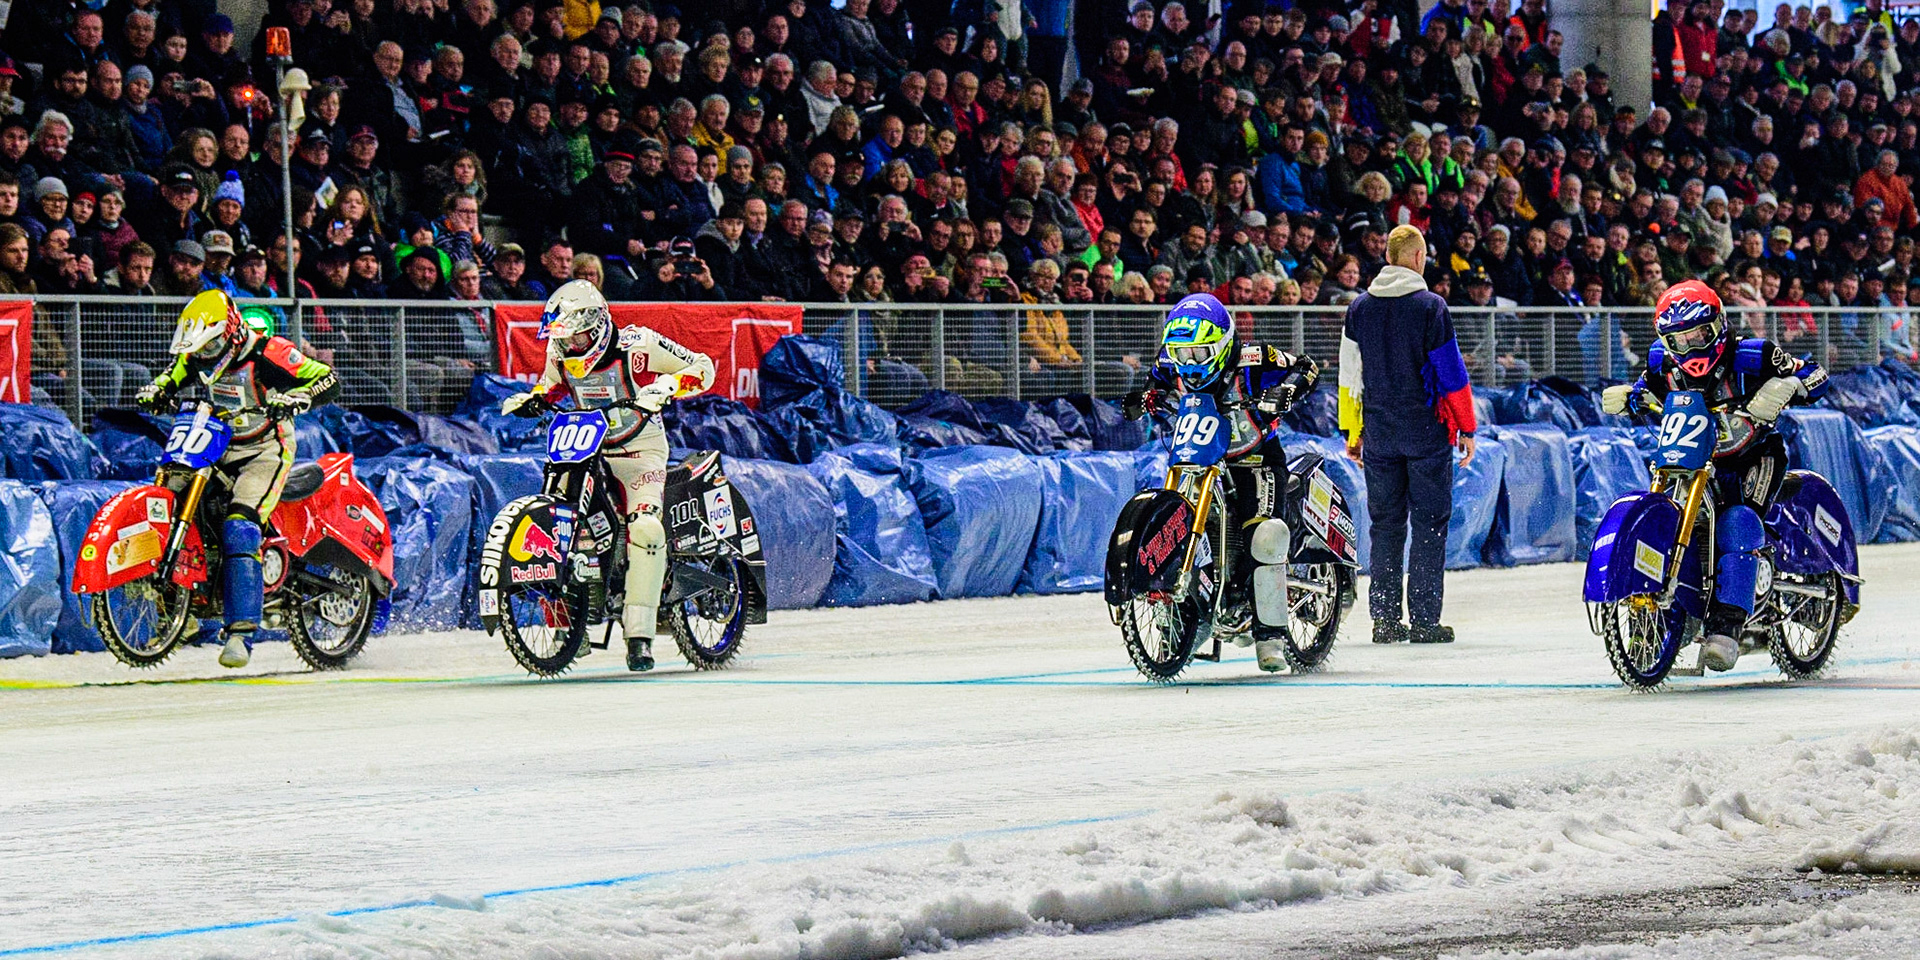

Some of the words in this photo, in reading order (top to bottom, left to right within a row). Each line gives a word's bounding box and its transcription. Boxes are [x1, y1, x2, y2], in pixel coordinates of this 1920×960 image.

[165, 425, 213, 454] 50
[549, 424, 598, 453] 100
[1171, 413, 1220, 450] 199
[1658, 412, 1709, 449] 192
[669, 497, 699, 528] 100
[709, 504, 732, 522] FUCHS
[556, 520, 572, 537] 100
[511, 564, 534, 583] Red
[534, 562, 557, 581] Bull
